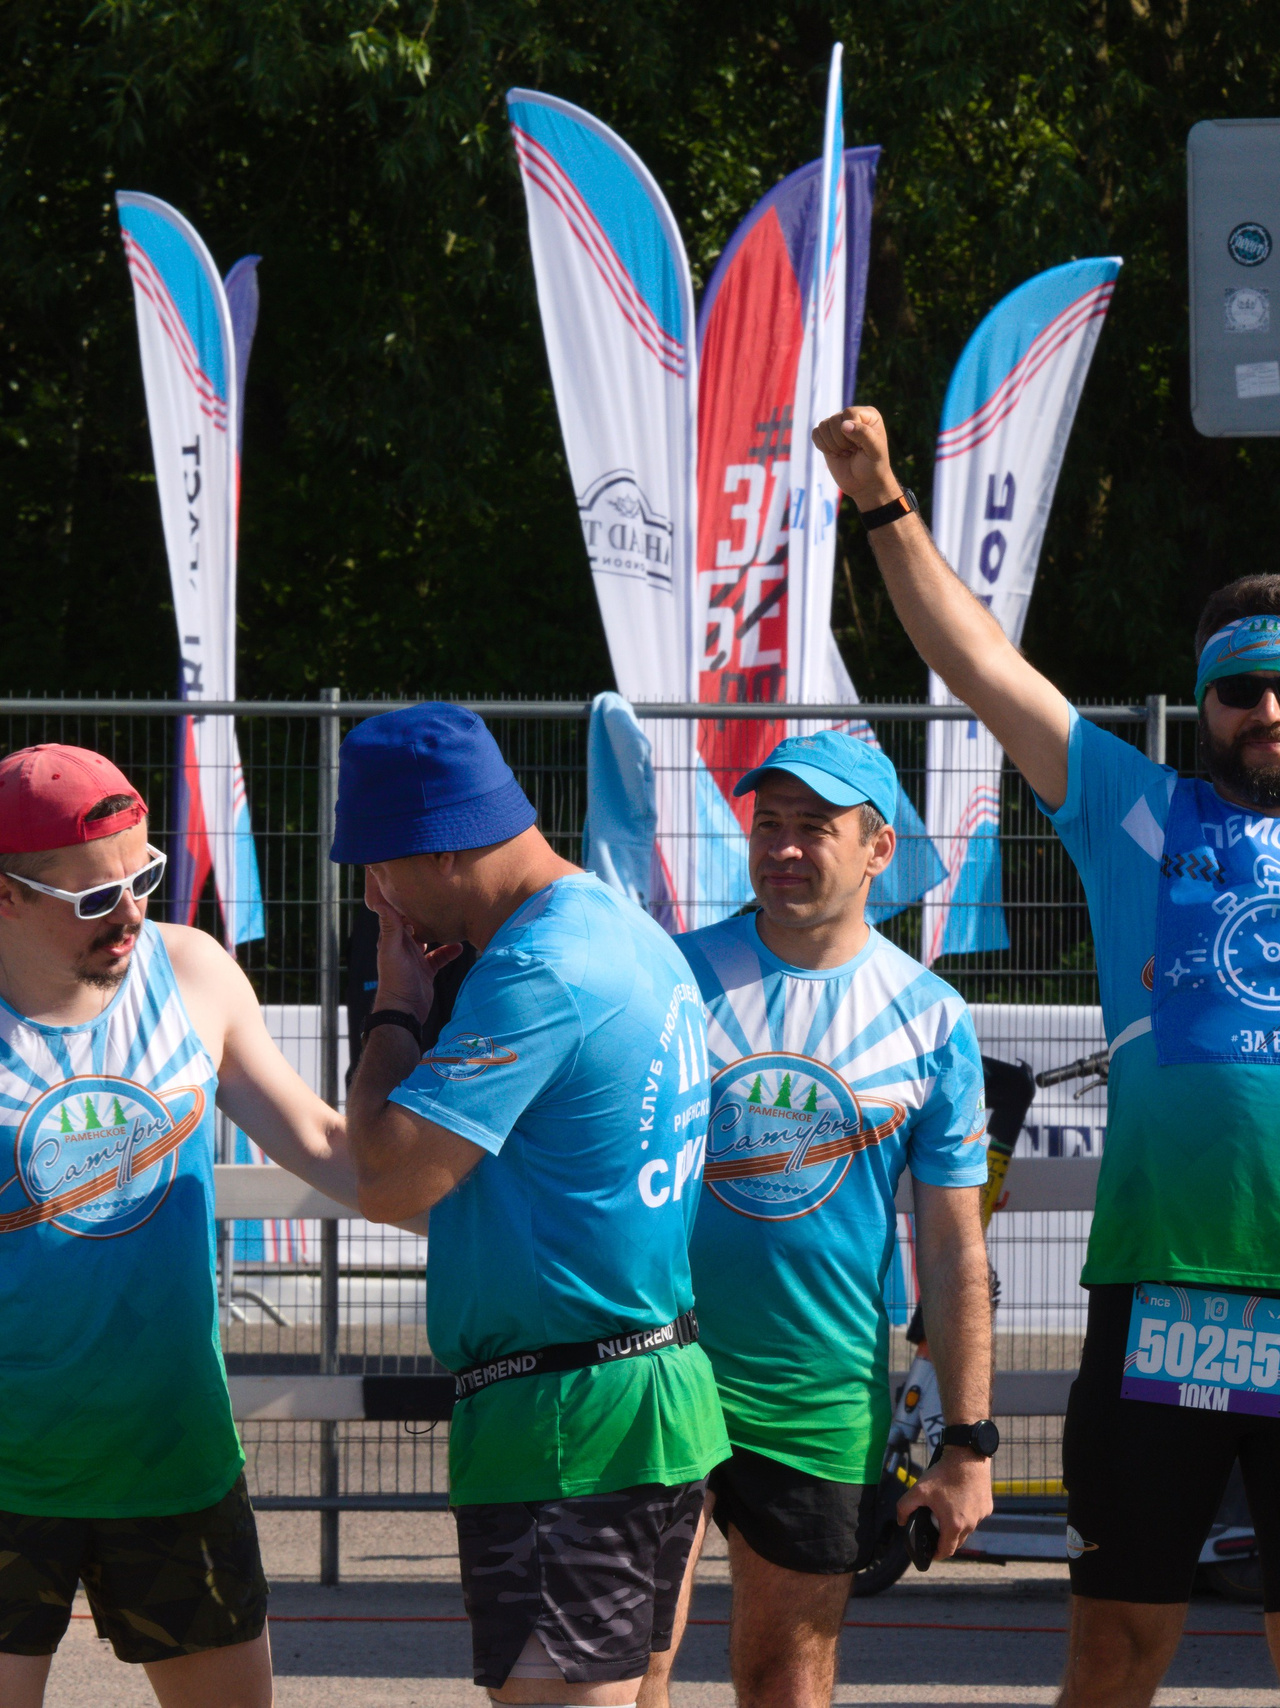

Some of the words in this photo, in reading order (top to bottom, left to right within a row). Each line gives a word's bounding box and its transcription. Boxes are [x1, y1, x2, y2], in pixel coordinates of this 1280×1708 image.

[639, 1058, 664, 1132] КЛУБ
[748, 1105, 813, 1123] РАМЕНСКОЕ
[64, 1125, 127, 1144] РАМЕНСКОЕ
[705, 1102, 861, 1176] Сатурн
[27, 1116, 171, 1197] Сатурн
[1150, 1296, 1171, 1309] ПСБ
[597, 1323, 675, 1360] NUTREND
[1178, 1382, 1230, 1412] 10KM
